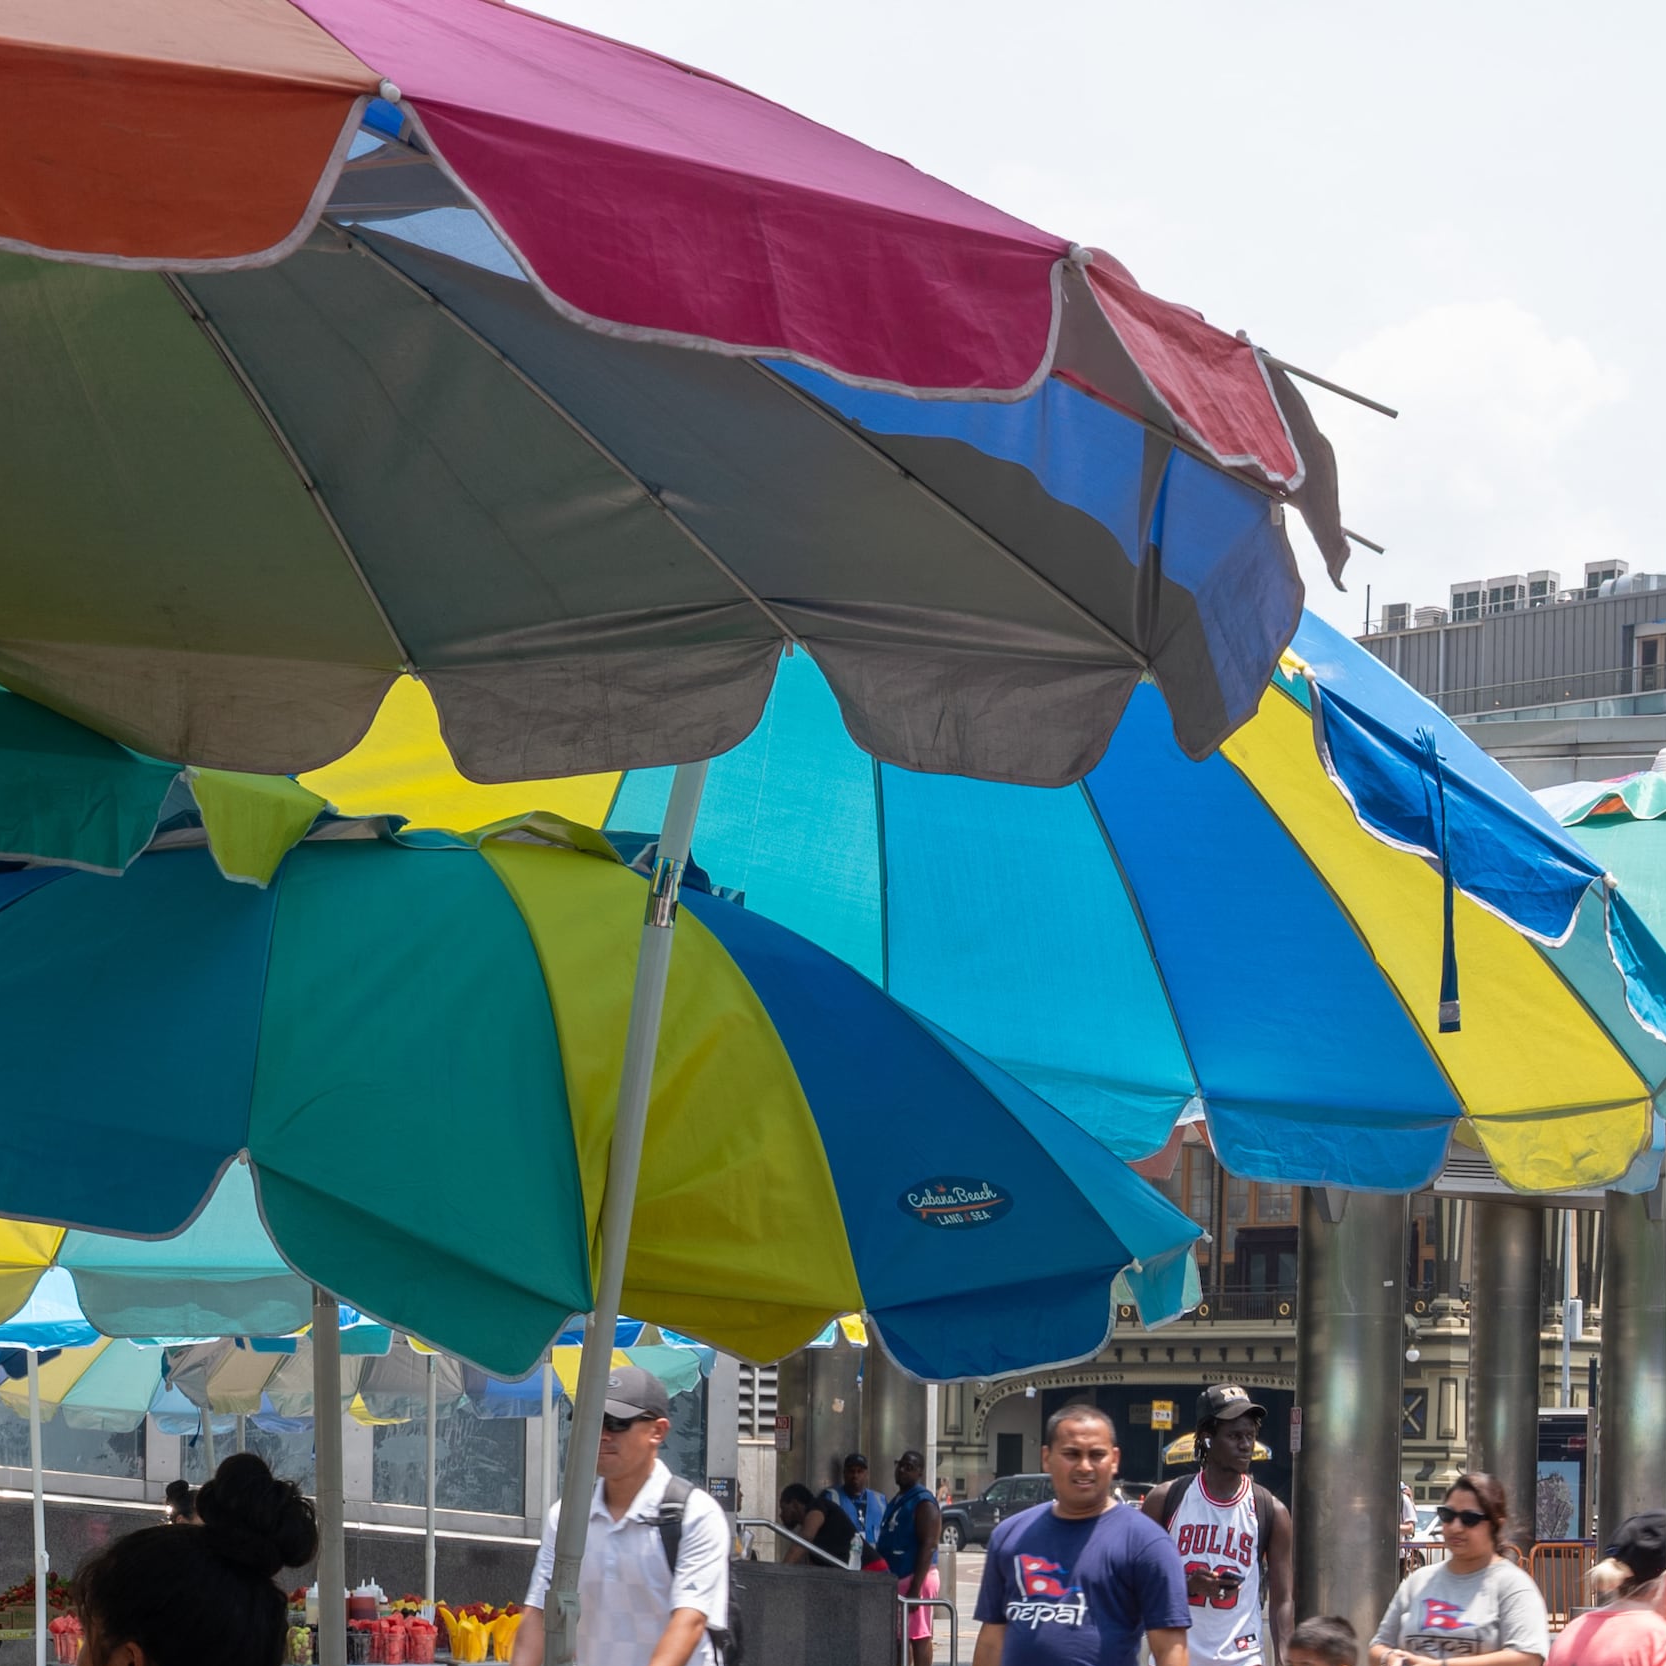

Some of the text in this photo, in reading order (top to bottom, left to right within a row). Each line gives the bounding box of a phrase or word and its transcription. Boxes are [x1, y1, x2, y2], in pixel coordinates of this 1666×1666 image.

[907, 1182, 997, 1208] Cabana Beach
[937, 1212, 964, 1225] LAND
[971, 1210, 990, 1221] SEA
[777, 1418, 787, 1428] NO
[1178, 1523, 1253, 1567] BULLS
[1006, 1592, 1088, 1630] nepal
